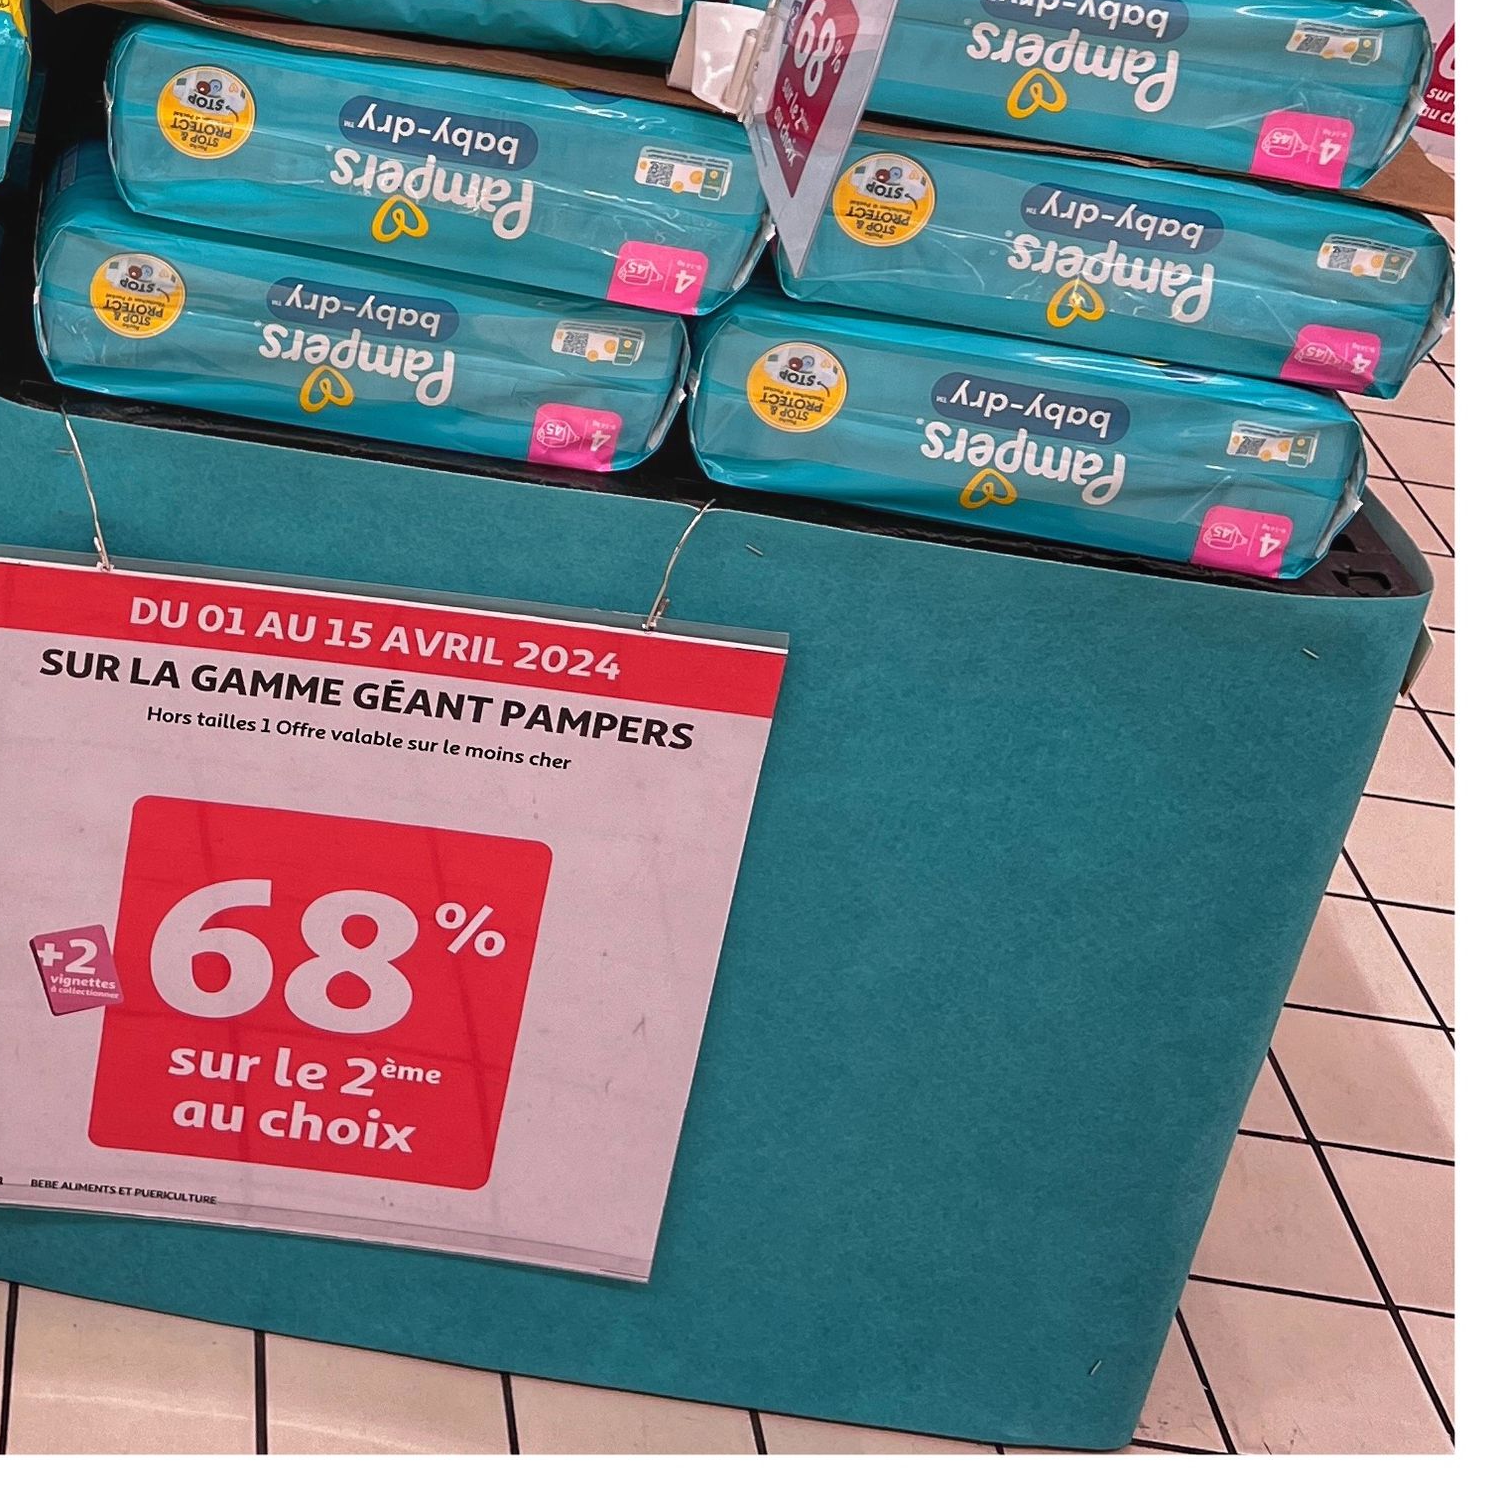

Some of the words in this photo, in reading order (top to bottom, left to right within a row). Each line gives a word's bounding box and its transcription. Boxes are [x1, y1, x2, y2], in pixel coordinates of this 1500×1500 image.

[966, 21, 1180, 113] Pampers
[188, 93, 225, 111] STOP
[1427, 87, 1452, 103] sur
[171, 118, 232, 139] PROTECT
[190, 135, 219, 147] STOP
[357, 102, 520, 164] baby-dry
[1319, 139, 1341, 165] 4
[329, 147, 533, 241] Pampers
[1041, 191, 1204, 246] baby-dry
[675, 269, 696, 293] 4
[1007, 232, 1215, 324] Pampers
[285, 284, 441, 335] baby-dry
[259, 323, 455, 406] Pampers
[950, 380, 1112, 431] baby-dry
[591, 430, 611, 452] 4
[921, 420, 1128, 507] Pampers
[1260, 532, 1281, 557] 4
[130, 596, 194, 632] DU
[197, 604, 245, 637] 01
[255, 607, 316, 643] AU
[325, 618, 370, 651] 15
[381, 623, 503, 668] AVRIL
[514, 640, 620, 682] 2024
[40, 648, 121, 683] SUR
[130, 657, 181, 690] LA
[191, 662, 342, 707] GAMME
[352, 679, 492, 726] GÉANT
[500, 701, 695, 751] PAMPERS
[146, 706, 190, 727] Hors
[196, 710, 255, 732] tailles
[260, 717, 271, 734] 1
[276, 719, 326, 740] Offre
[330, 725, 403, 748] valable
[408, 736, 438, 752] sur
[442, 737, 459, 754] le
[464, 740, 523, 765] moins
[529, 748, 572, 771] cher
[37, 936, 100, 975] +2
[49, 973, 117, 993] vignettes
[50, 984, 58, 994] à
[59, 985, 120, 1001] collectionner
[167, 1046, 260, 1084] sur
[274, 1046, 324, 1092] le
[340, 1056, 442, 1098] 2ème
[172, 1099, 249, 1136] au
[258, 1099, 417, 1154] choix
[30, 1178, 59, 1190] BEBE
[60, 1181, 117, 1196] ALIMENTS
[118, 1186, 132, 1197] ET
[133, 1188, 217, 1205] PUERICULTURE
